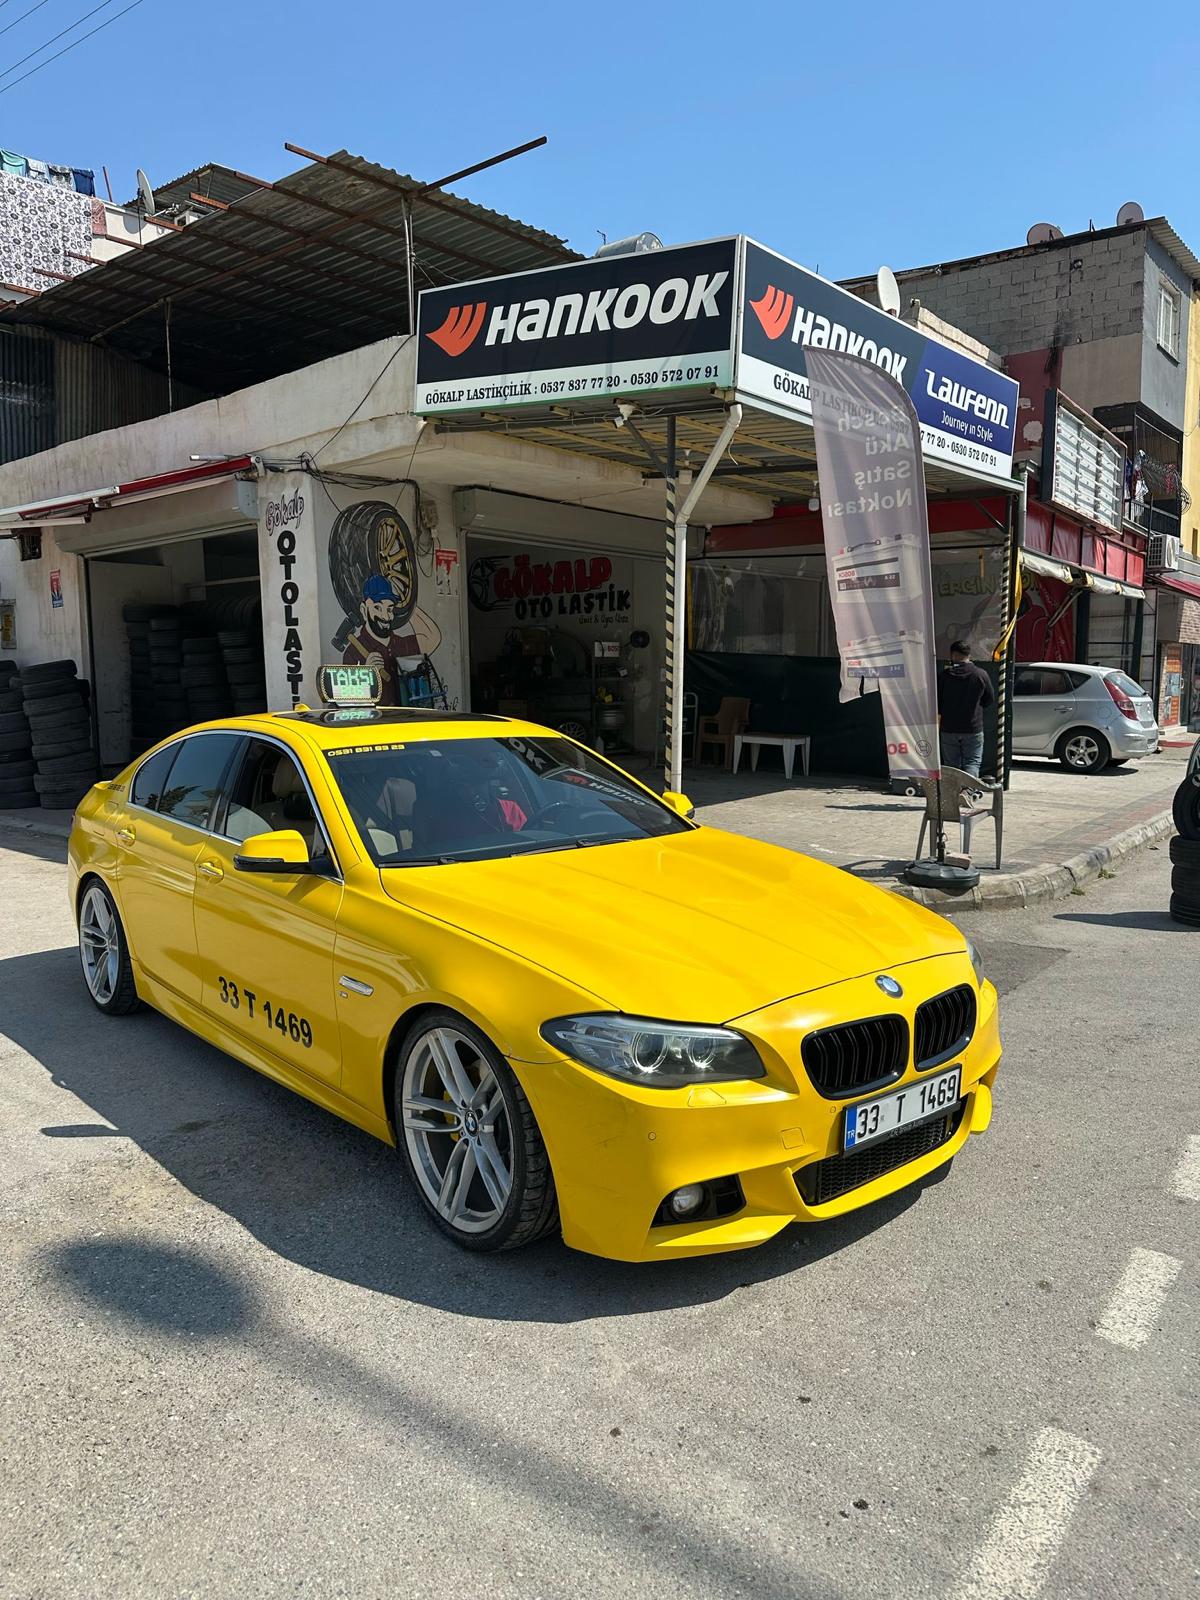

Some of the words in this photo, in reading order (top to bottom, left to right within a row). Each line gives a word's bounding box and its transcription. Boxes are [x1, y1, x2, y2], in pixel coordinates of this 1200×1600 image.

[425, 388, 465, 405] GÖKALP
[466, 383, 532, 402] LASTİKÇİLİK
[540, 381, 565, 394] 0537
[568, 378, 587, 391] 837
[590, 377, 604, 389] 77
[606, 375, 620, 388] 20
[630, 372, 658, 386] 0530
[661, 369, 684, 382] 572
[686, 366, 702, 380] 07
[704, 364, 719, 377] 91
[941, 410, 969, 436] Journey
[969, 424, 976, 435] in
[977, 424, 993, 443] Style
[926, 432, 936, 445] 77
[936, 436, 946, 449] 20
[951, 441, 967, 456] 0530
[968, 447, 980, 461] 572
[980, 451, 989, 463] 07
[989, 455, 997, 467] 91
[495, 554, 612, 598] GÖKALP
[515, 596, 553, 620] OTO
[558, 584, 631, 615] LASTİK
[218, 976, 240, 1009] 33
[244, 989, 256, 1018] T
[263, 1001, 313, 1049] 1469
[858, 1105, 879, 1138] 33
[896, 1093, 906, 1123] T
[920, 1075, 956, 1113] 1469
